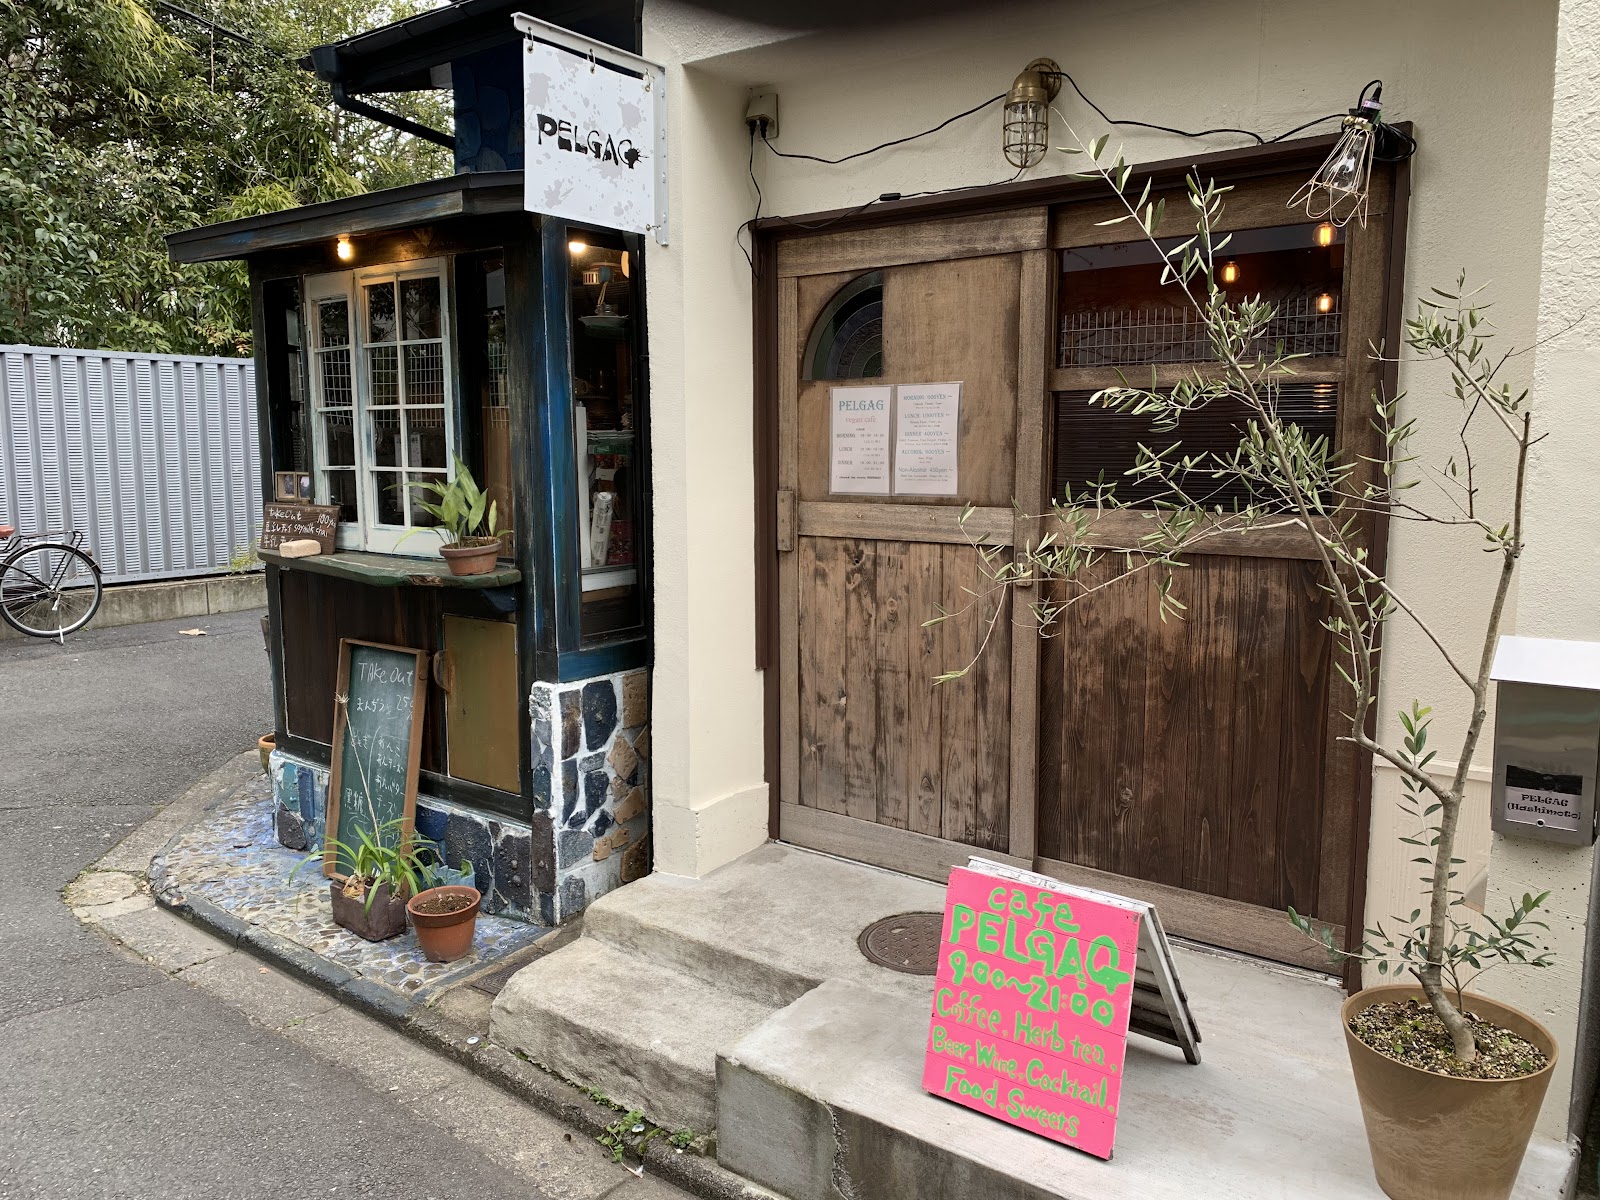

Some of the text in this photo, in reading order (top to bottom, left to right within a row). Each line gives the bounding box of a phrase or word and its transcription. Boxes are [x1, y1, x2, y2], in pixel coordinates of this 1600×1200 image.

[839, 400, 884, 411] PELGAG
[845, 416, 863, 424] vegan
[1521, 794, 1569, 807] PELGAG
[1507, 802, 1582, 820] (Hashimoto)
[988, 887, 1080, 932] cafe
[1014, 1011, 1065, 1052] Herb
[1006, 1088, 1080, 1137] Sweets
